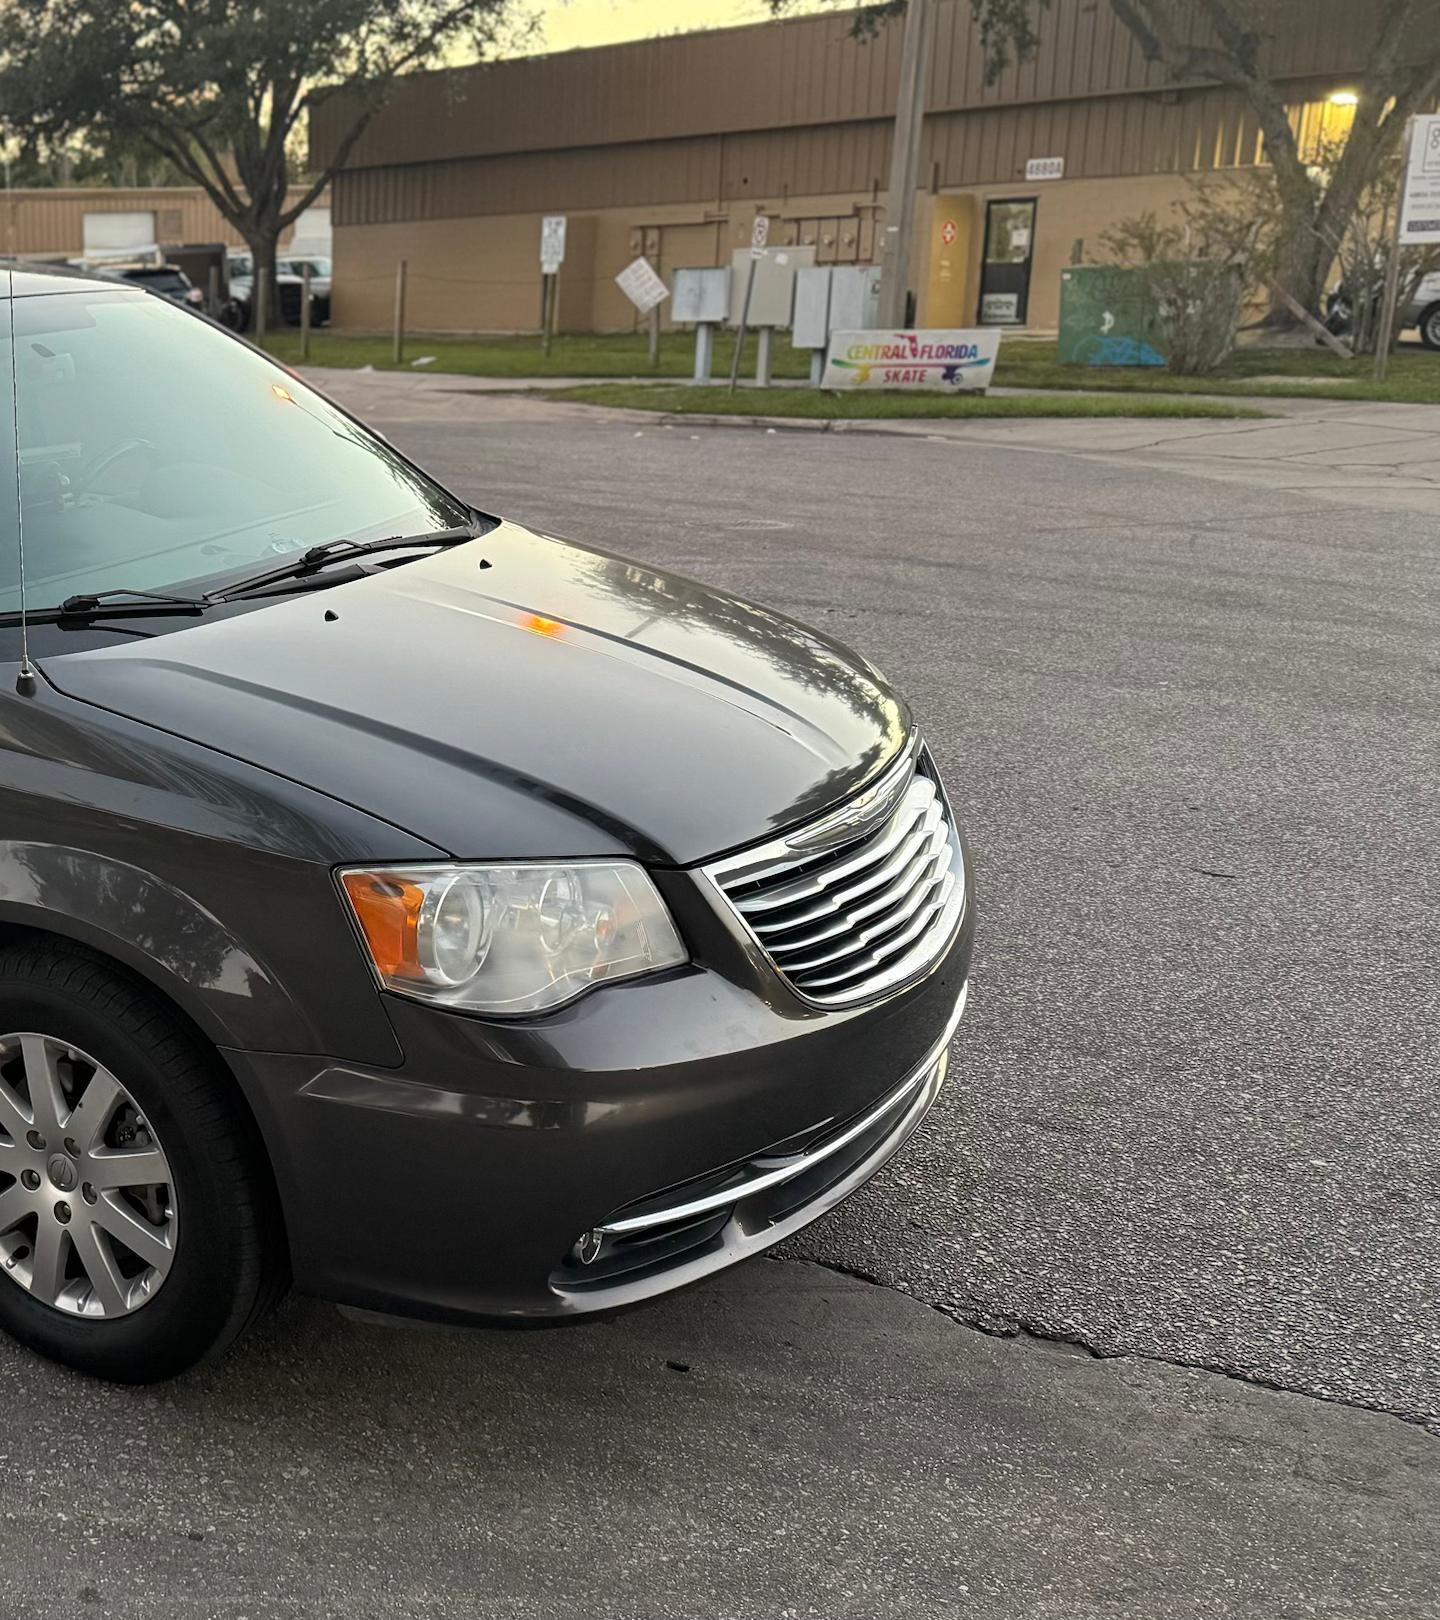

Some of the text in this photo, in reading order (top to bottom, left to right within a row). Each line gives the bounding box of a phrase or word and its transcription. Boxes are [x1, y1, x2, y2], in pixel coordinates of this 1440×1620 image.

[847, 344, 978, 359] CENTRAL FLORIDA
[883, 370, 927, 383] SKATE
